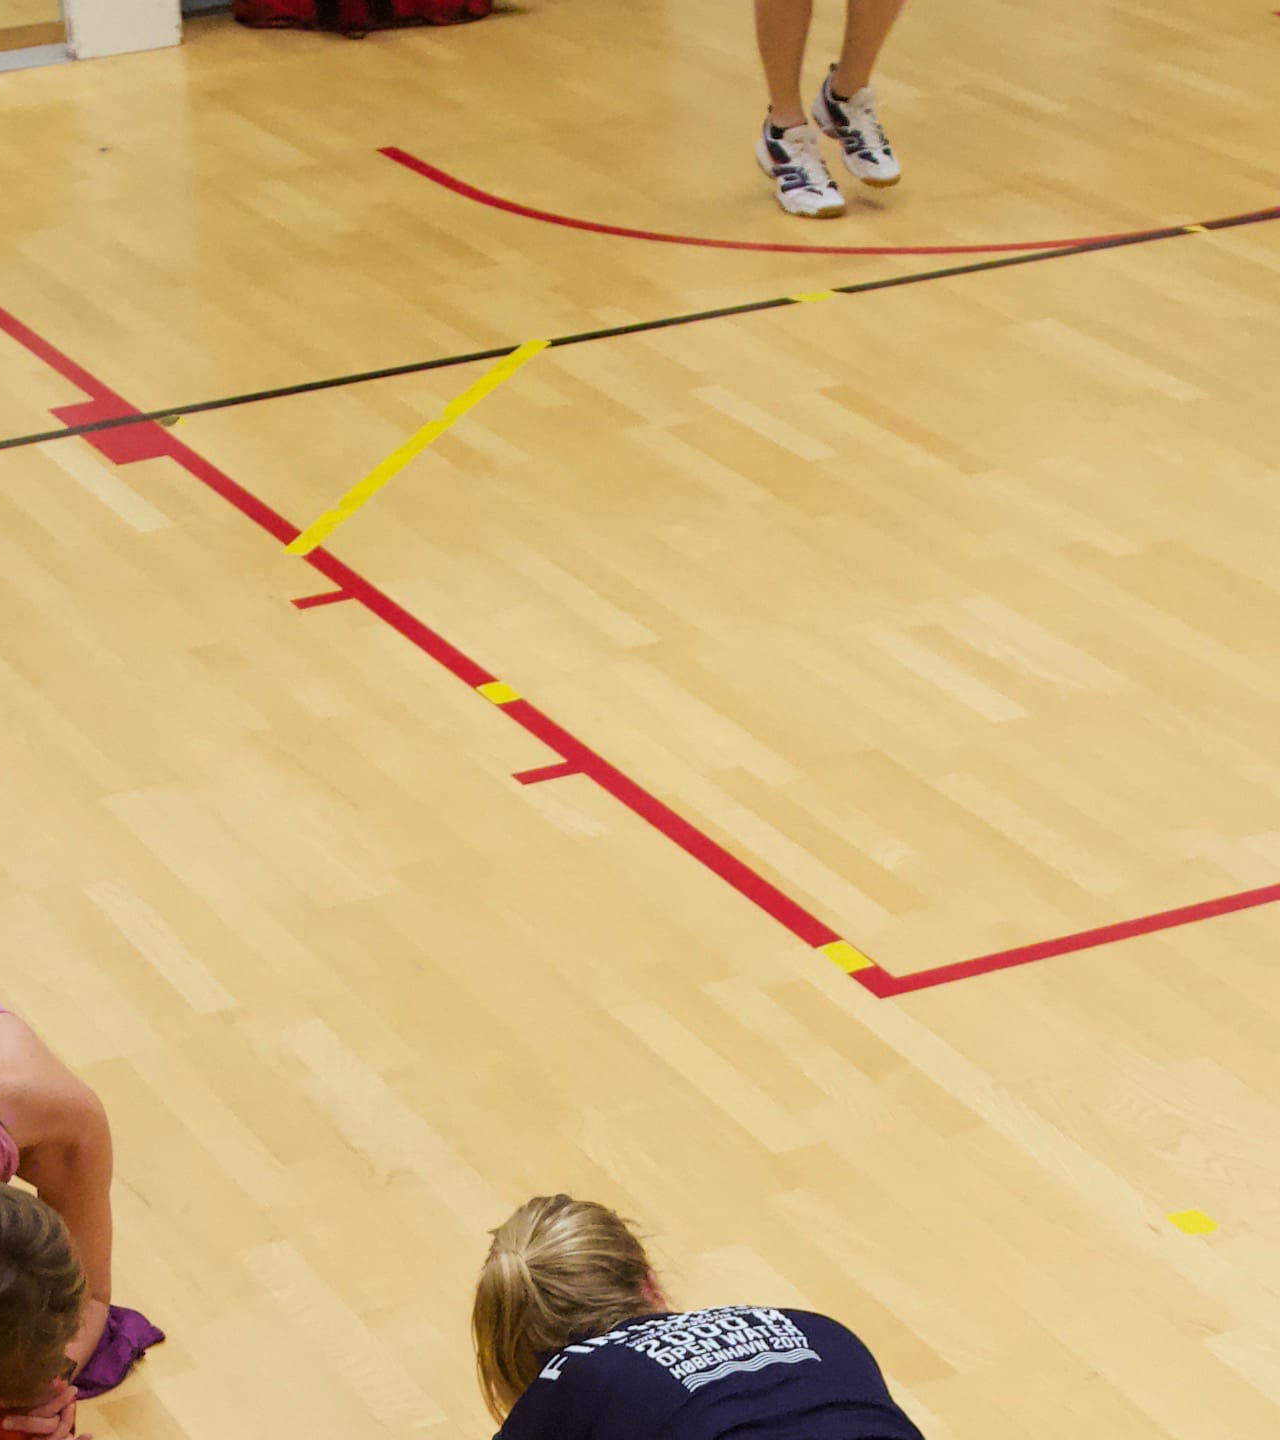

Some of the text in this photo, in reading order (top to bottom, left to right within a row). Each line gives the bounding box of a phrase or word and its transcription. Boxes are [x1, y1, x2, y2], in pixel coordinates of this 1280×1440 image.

[634, 1316, 750, 1359] 2000
[655, 1336, 722, 1367] OPEN
[720, 1324, 805, 1347] WATER
[668, 1335, 809, 1380] KØBENHAVN 2017
